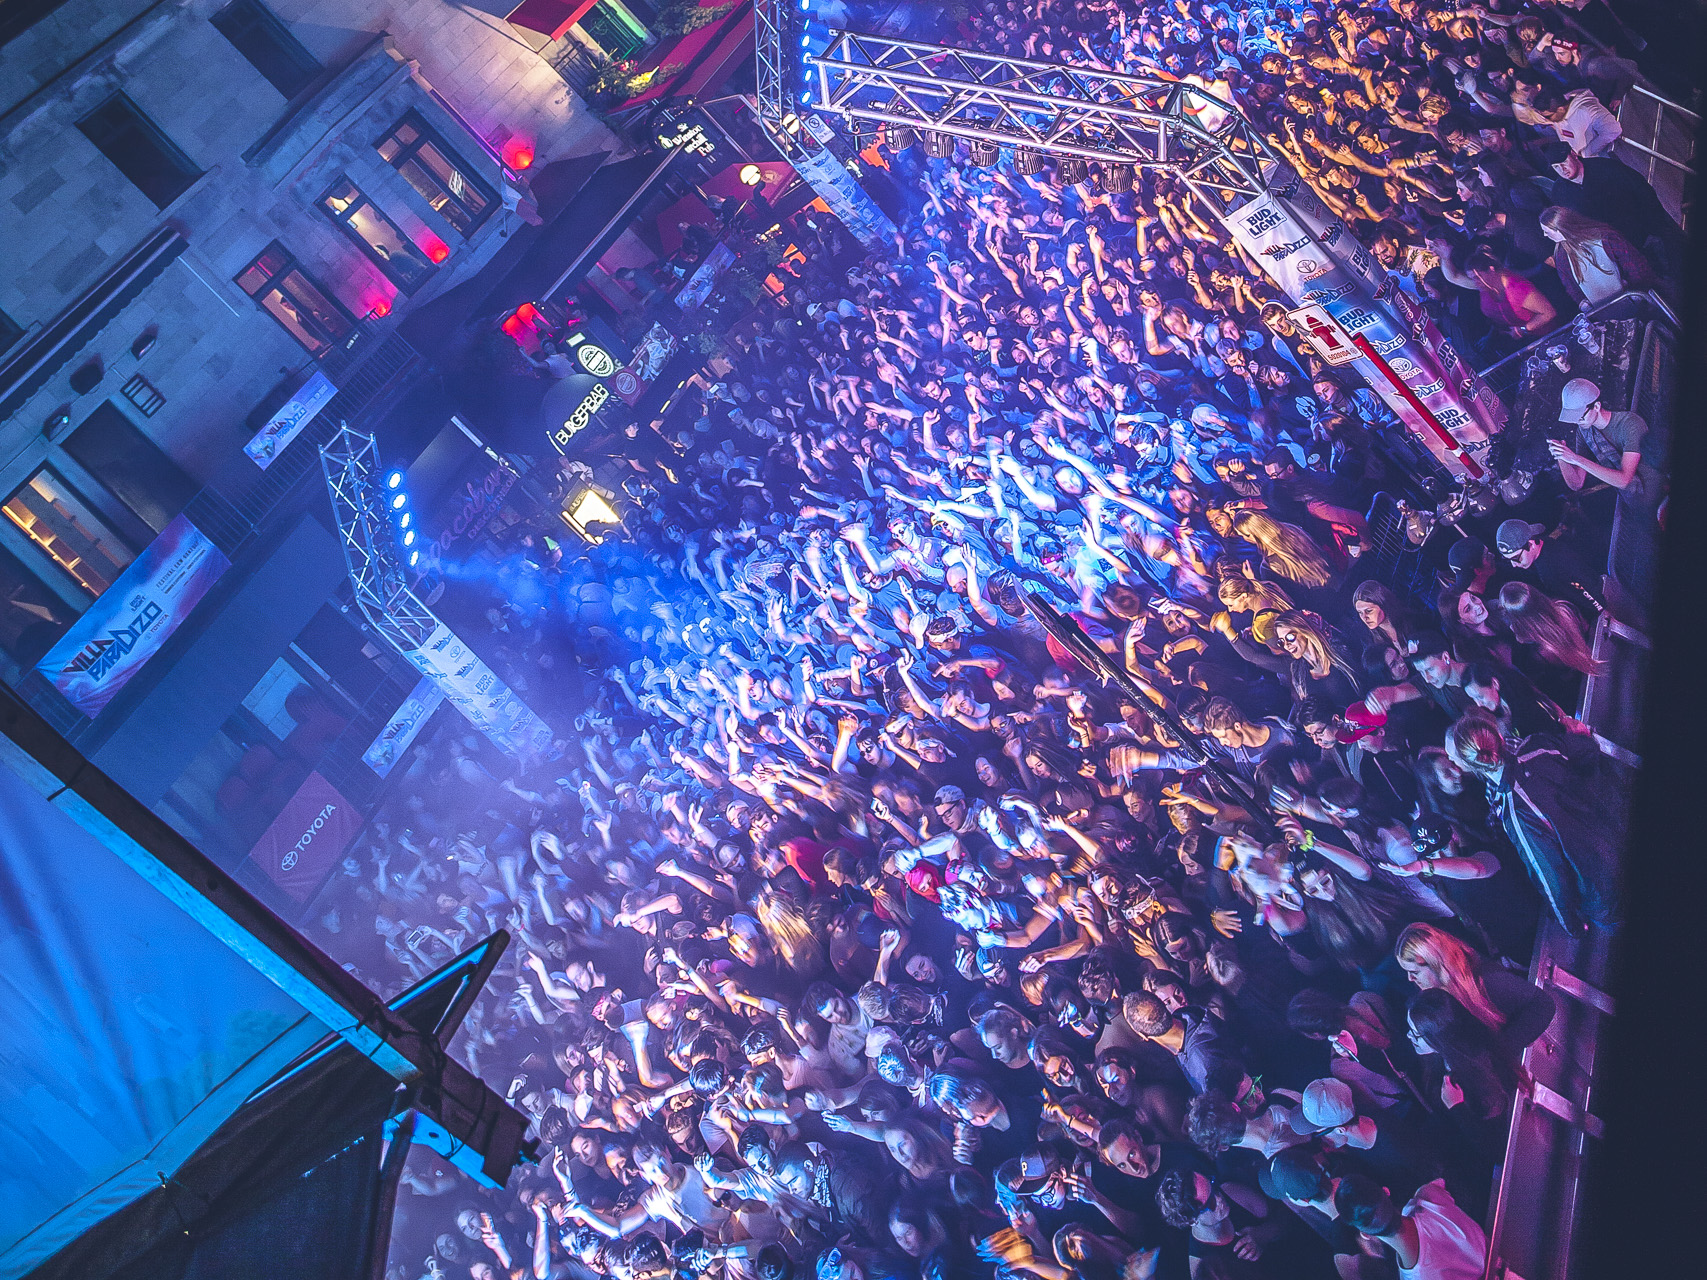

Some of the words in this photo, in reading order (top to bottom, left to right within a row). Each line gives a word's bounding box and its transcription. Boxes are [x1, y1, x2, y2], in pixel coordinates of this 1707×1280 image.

[697, 142, 715, 157] Pub
[1247, 207, 1272, 227] BUD
[1248, 211, 1284, 236] LIGHT
[1260, 243, 1285, 257] VILLA
[1273, 235, 1312, 261] PARADIZO
[1303, 268, 1328, 282] TOYOTA
[1303, 289, 1329, 301] VILLA
[1338, 307, 1365, 326] BUD
[1400, 368, 1421, 380] OYOTA
[1435, 408, 1459, 424] BUD
[1442, 413, 1468, 430] IGHT
[86, 600, 163, 682] PARADIZO
[61, 639, 116, 673] VILLA
[295, 804, 337, 851] TOYOTA
